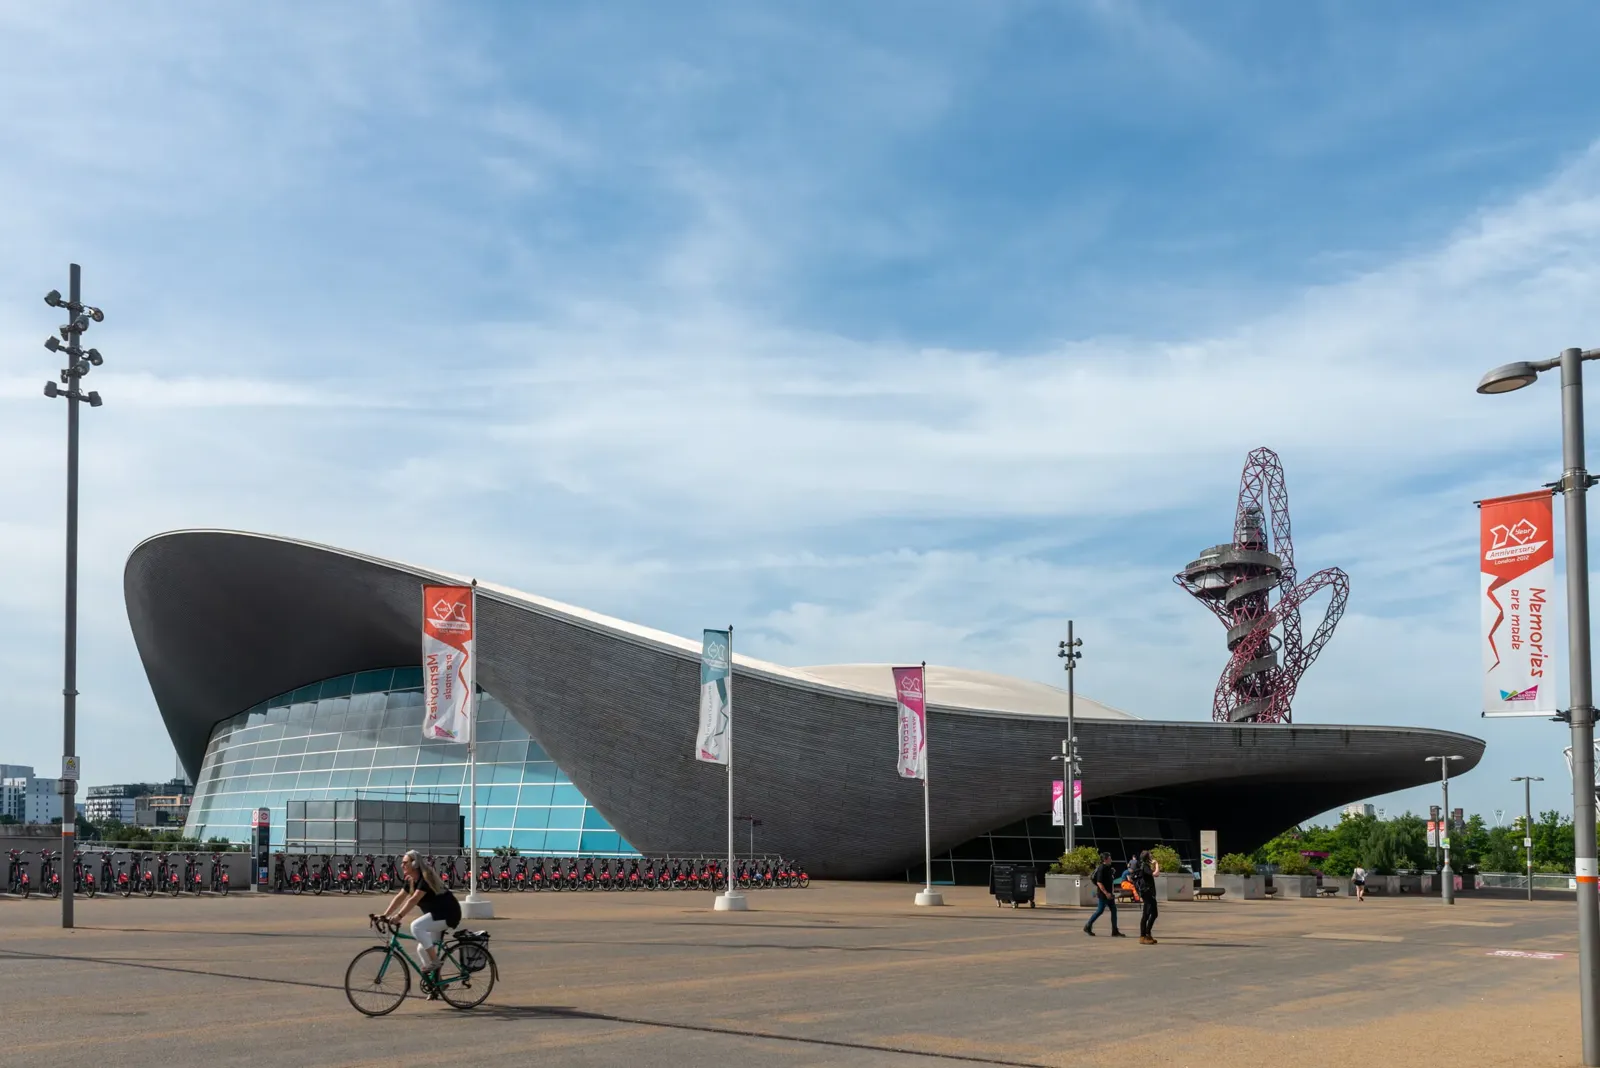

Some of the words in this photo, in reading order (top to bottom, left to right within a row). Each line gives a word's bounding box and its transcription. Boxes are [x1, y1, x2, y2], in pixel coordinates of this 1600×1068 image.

[1489, 545, 1536, 558] Anniversary
[1494, 557, 1516, 565] London
[1510, 589, 1520, 610] are
[1511, 614, 1524, 651] made
[1528, 587, 1548, 678] Memories
